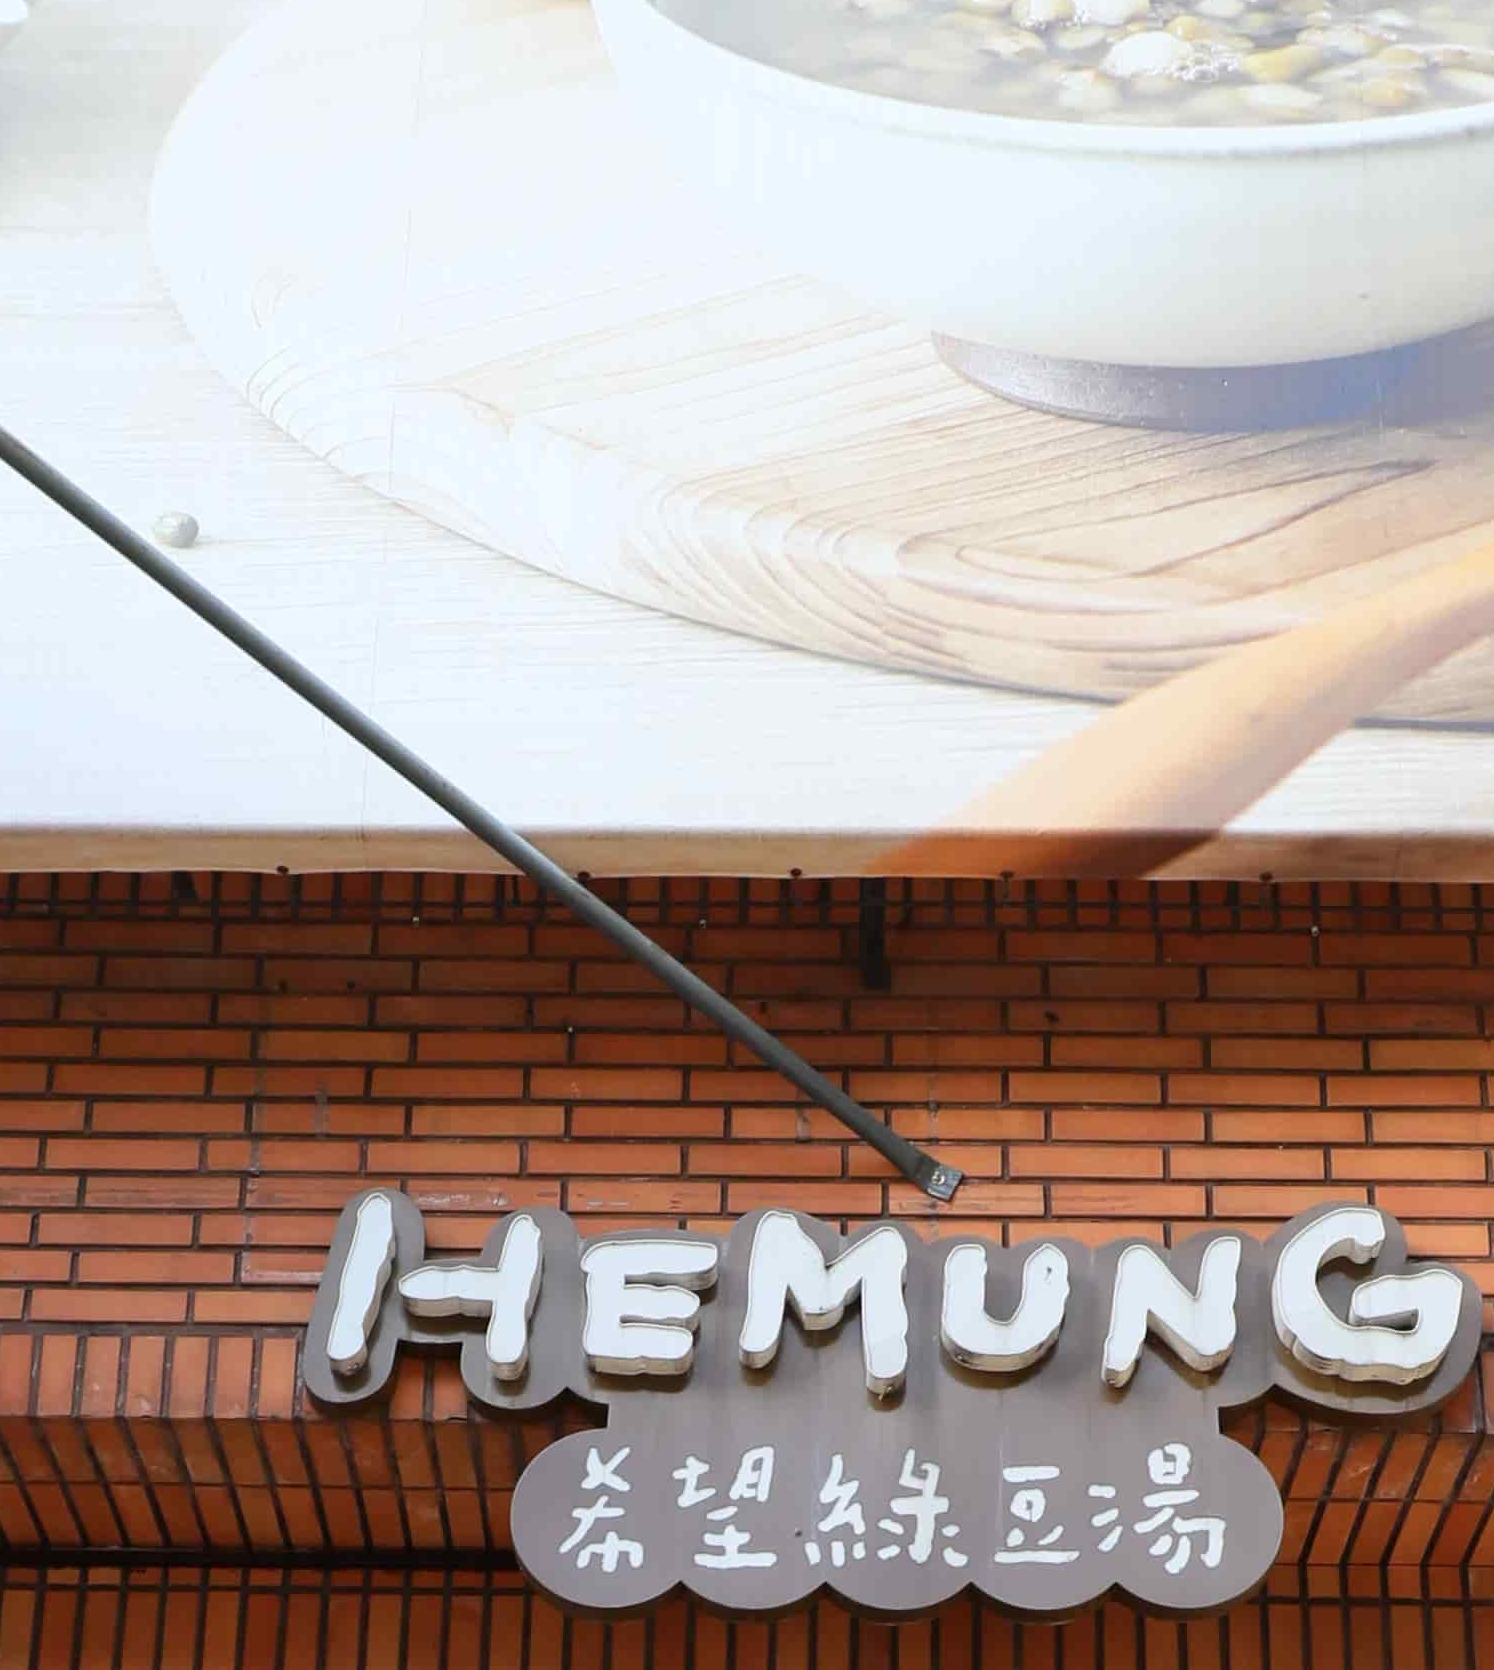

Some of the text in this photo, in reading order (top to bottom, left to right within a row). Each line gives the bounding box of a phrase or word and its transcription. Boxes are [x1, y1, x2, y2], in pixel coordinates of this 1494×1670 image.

[325, 1190, 1467, 1398] HEMUNG
[558, 1442, 1226, 1575] 希望綠豆湯
